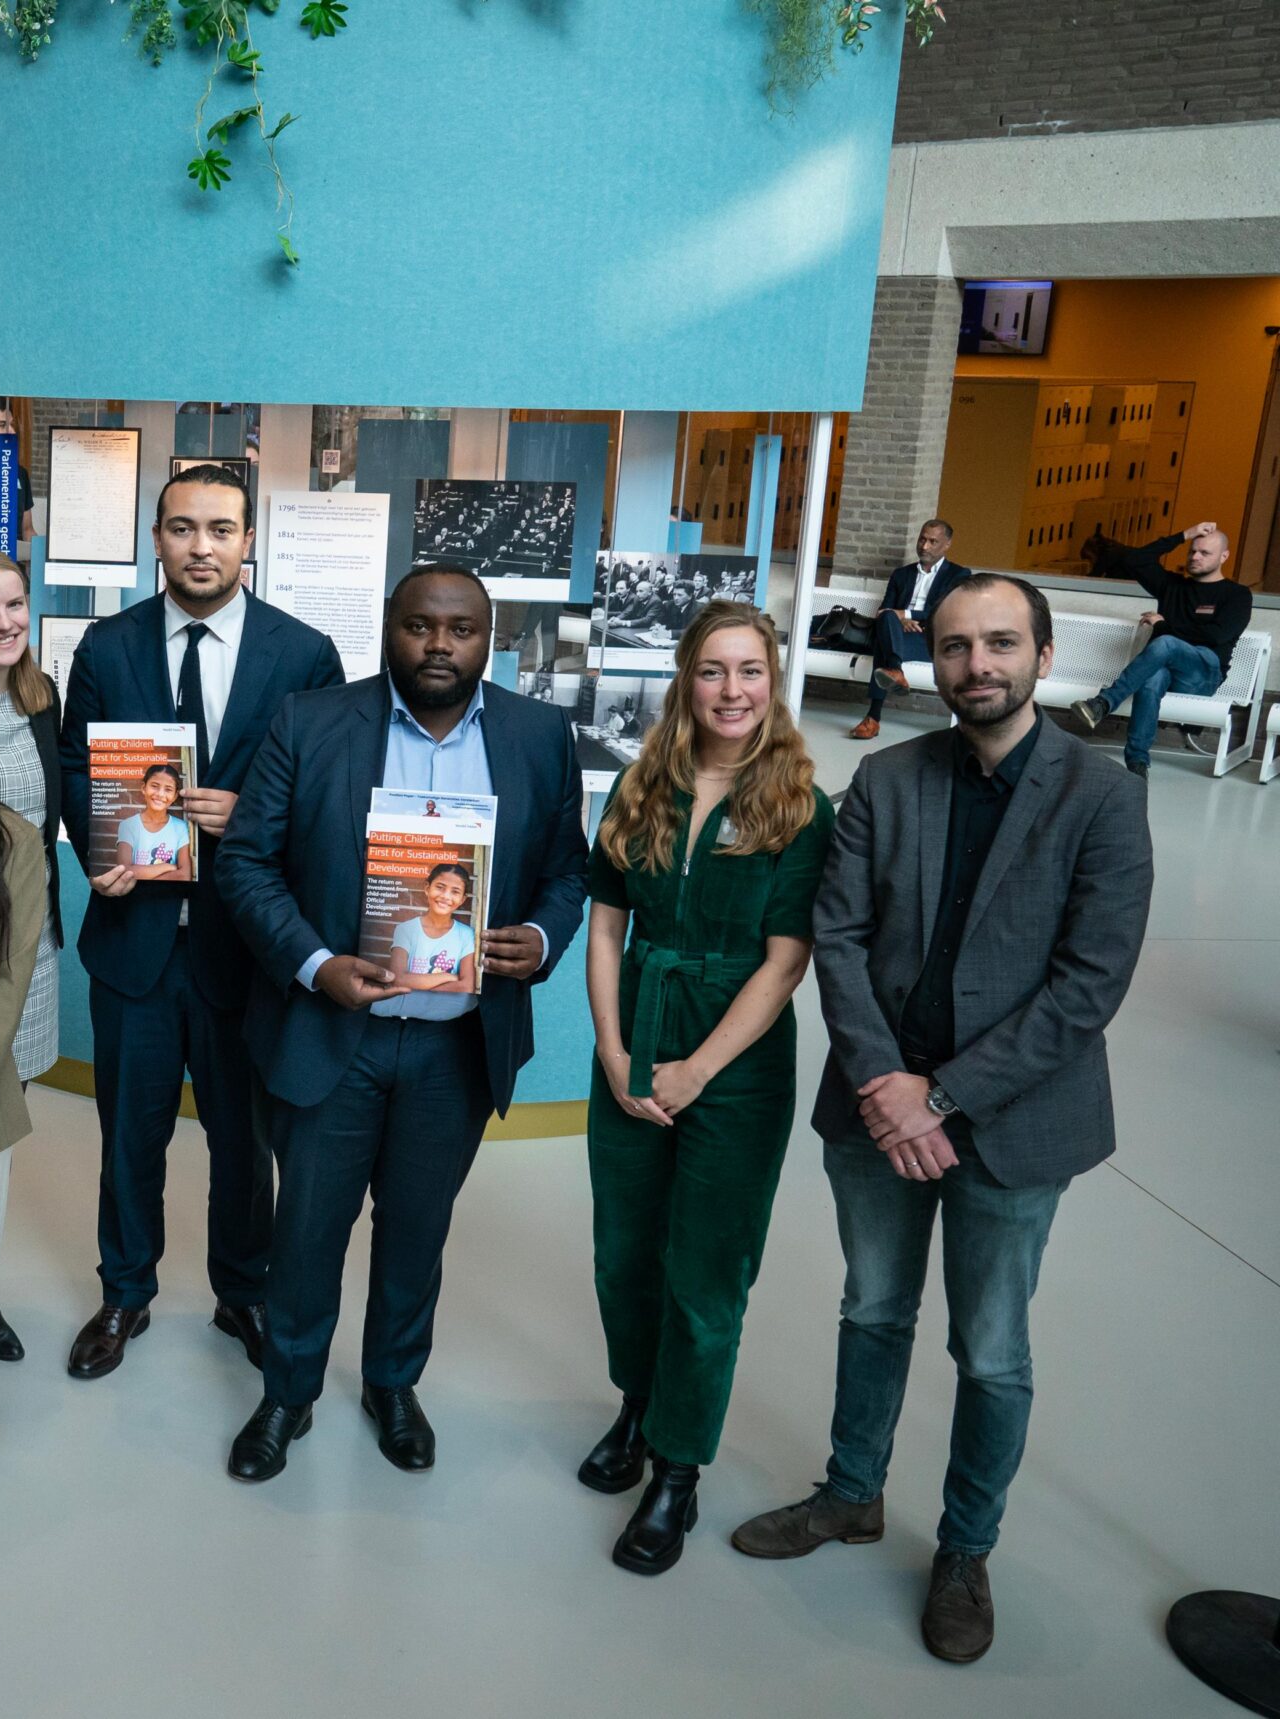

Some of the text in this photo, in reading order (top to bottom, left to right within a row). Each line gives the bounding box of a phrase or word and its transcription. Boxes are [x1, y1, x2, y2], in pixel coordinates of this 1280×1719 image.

[0, 449, 12, 523] Parlementaire
[277, 531, 295, 539] 1814
[276, 553, 294, 561] 1815
[91, 739, 153, 750] Putting Children
[91, 753, 167, 762] First for Sustainable
[370, 832, 443, 845] Putting Children
[369, 848, 457, 861] First for Sustainable
